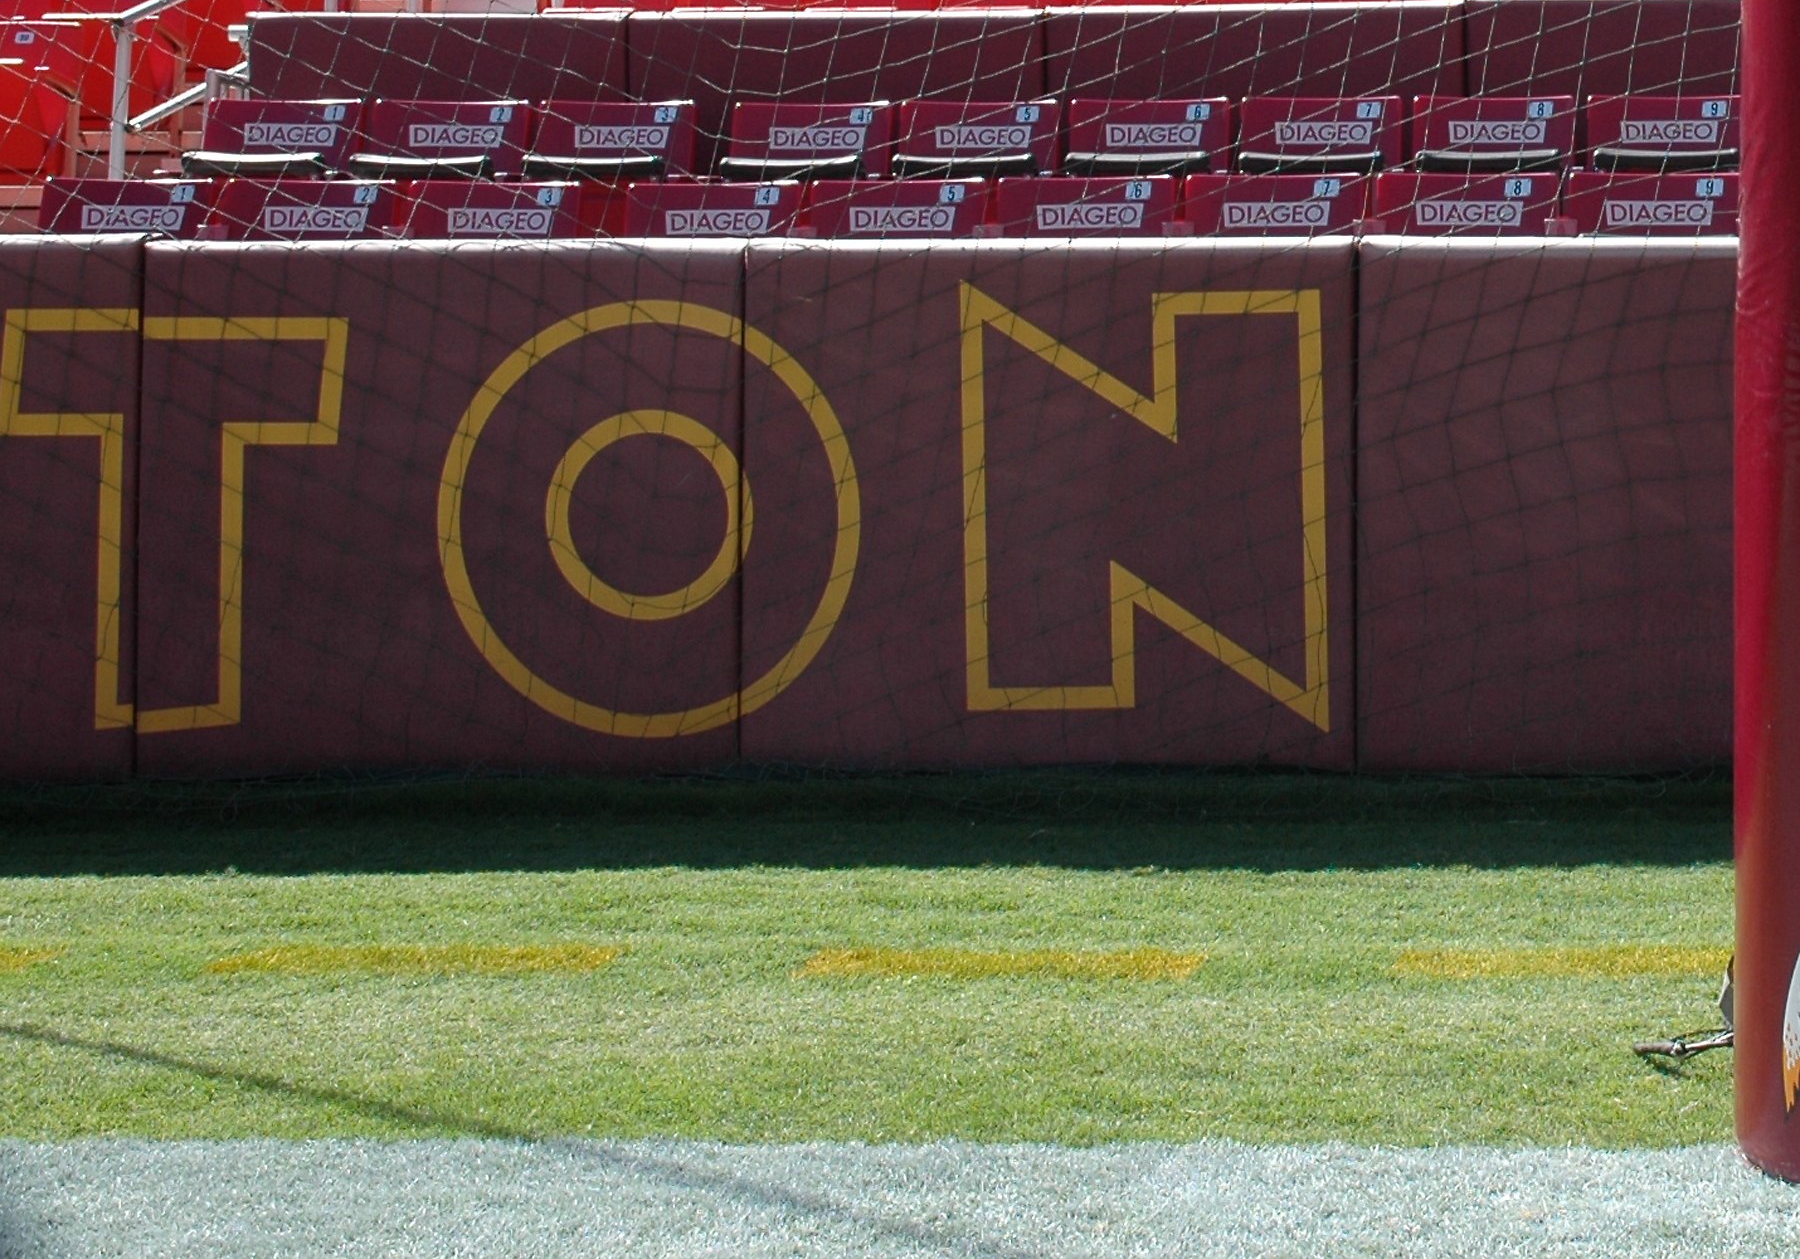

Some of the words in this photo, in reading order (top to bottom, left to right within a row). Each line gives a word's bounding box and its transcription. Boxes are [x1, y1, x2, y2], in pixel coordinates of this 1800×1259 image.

[247, 124, 333, 144] DIAGEO
[413, 126, 500, 145] DIAGEO
[578, 127, 666, 146] DIAGEO
[774, 127, 862, 147] DIAGEO
[940, 126, 1028, 145] DIAGEO
[1110, 125, 1197, 144] DIAGEO
[1279, 122, 1369, 142] DIAGEO
[1453, 122, 1541, 141] DIAGEO
[1624, 121, 1714, 140] DIAGEO
[87, 206, 182, 228] DIAGEO
[270, 207, 364, 229] DIAGEO
[452, 209, 547, 231] DIAGEO
[670, 210, 765, 232] DIAGEO
[855, 207, 951, 228] DIAGEO
[1041, 204, 1138, 226] DIAGEO
[1228, 203, 1326, 224] DIAGEO
[1420, 203, 1519, 224] DIAGEO
[1611, 202, 1709, 223] DIAGEO
[0, 281, 1330, 738] TON
